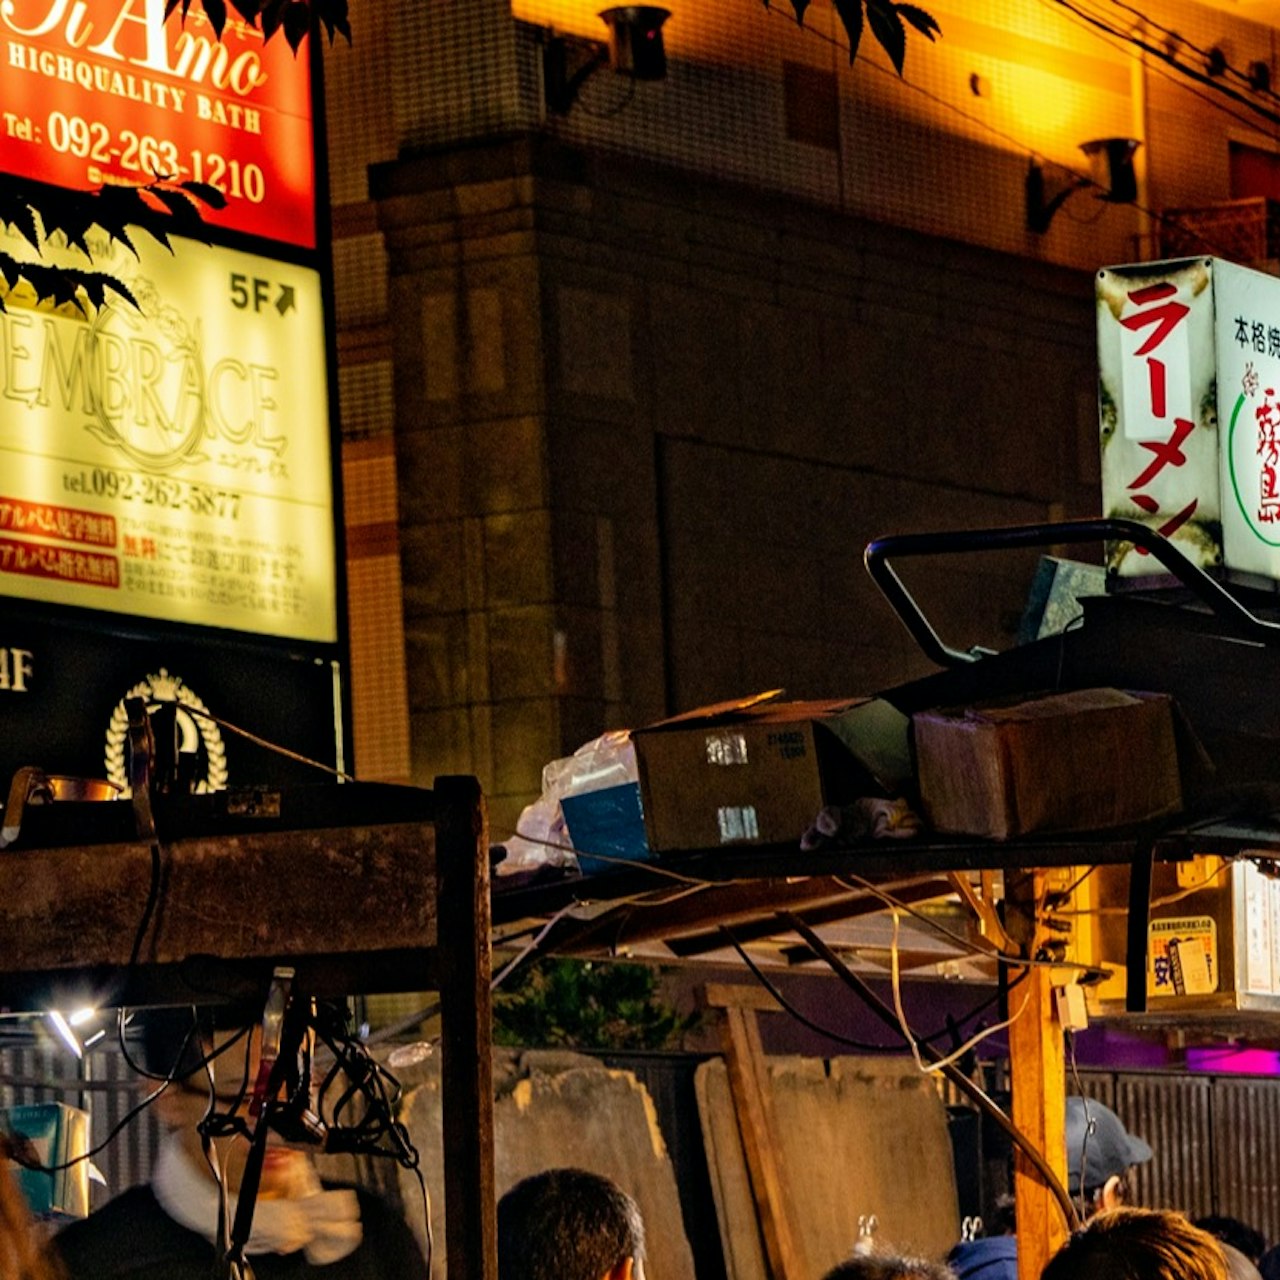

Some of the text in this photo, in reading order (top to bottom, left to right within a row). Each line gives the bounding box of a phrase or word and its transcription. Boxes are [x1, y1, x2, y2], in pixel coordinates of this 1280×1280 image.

[8, 40, 262, 135] HIGHQUALITY BATH
[3, 110, 266, 204] Tel: 092-263-1210
[229, 272, 273, 313] 5F
[2, 311, 288, 457] EMBRACE
[1120, 281, 1199, 557] ラーメン
